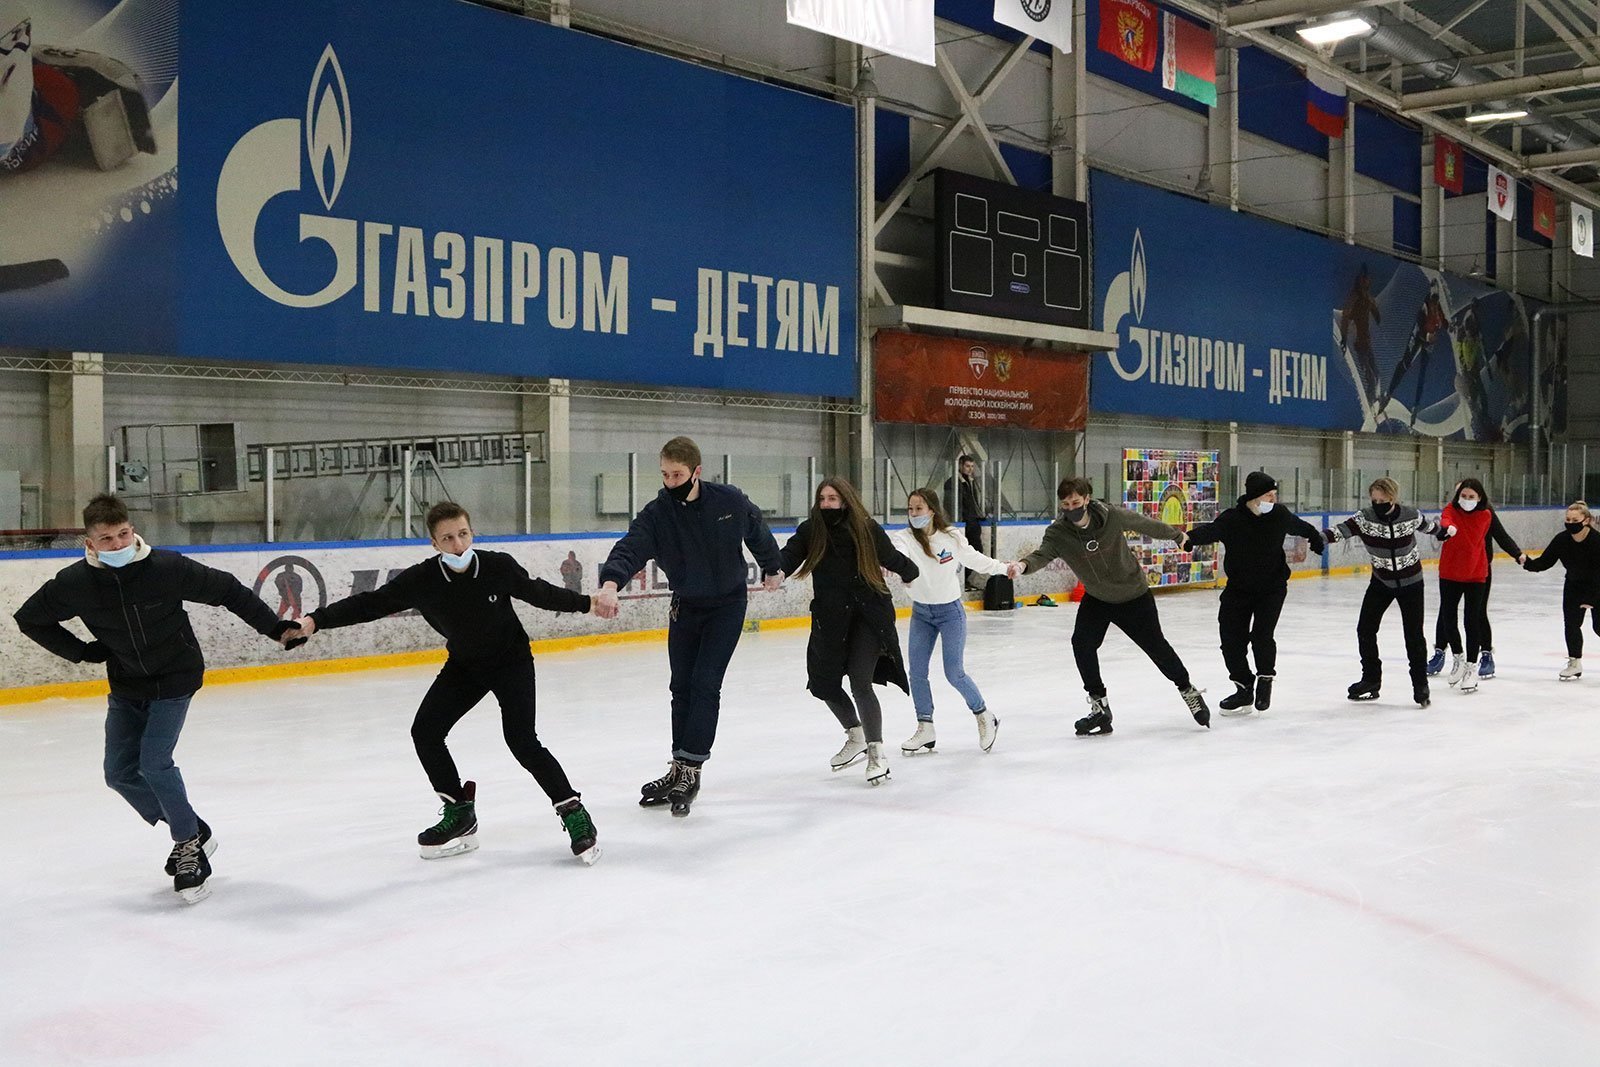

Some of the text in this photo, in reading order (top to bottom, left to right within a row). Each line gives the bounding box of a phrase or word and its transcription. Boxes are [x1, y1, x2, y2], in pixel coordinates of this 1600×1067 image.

[364, 222, 628, 334] ГАЗПРОМ
[694, 268, 840, 358] ДЕТЯМ
[1150, 329, 1245, 392] ГАЗПРОМ
[1268, 348, 1327, 405] ДЕТЯМ
